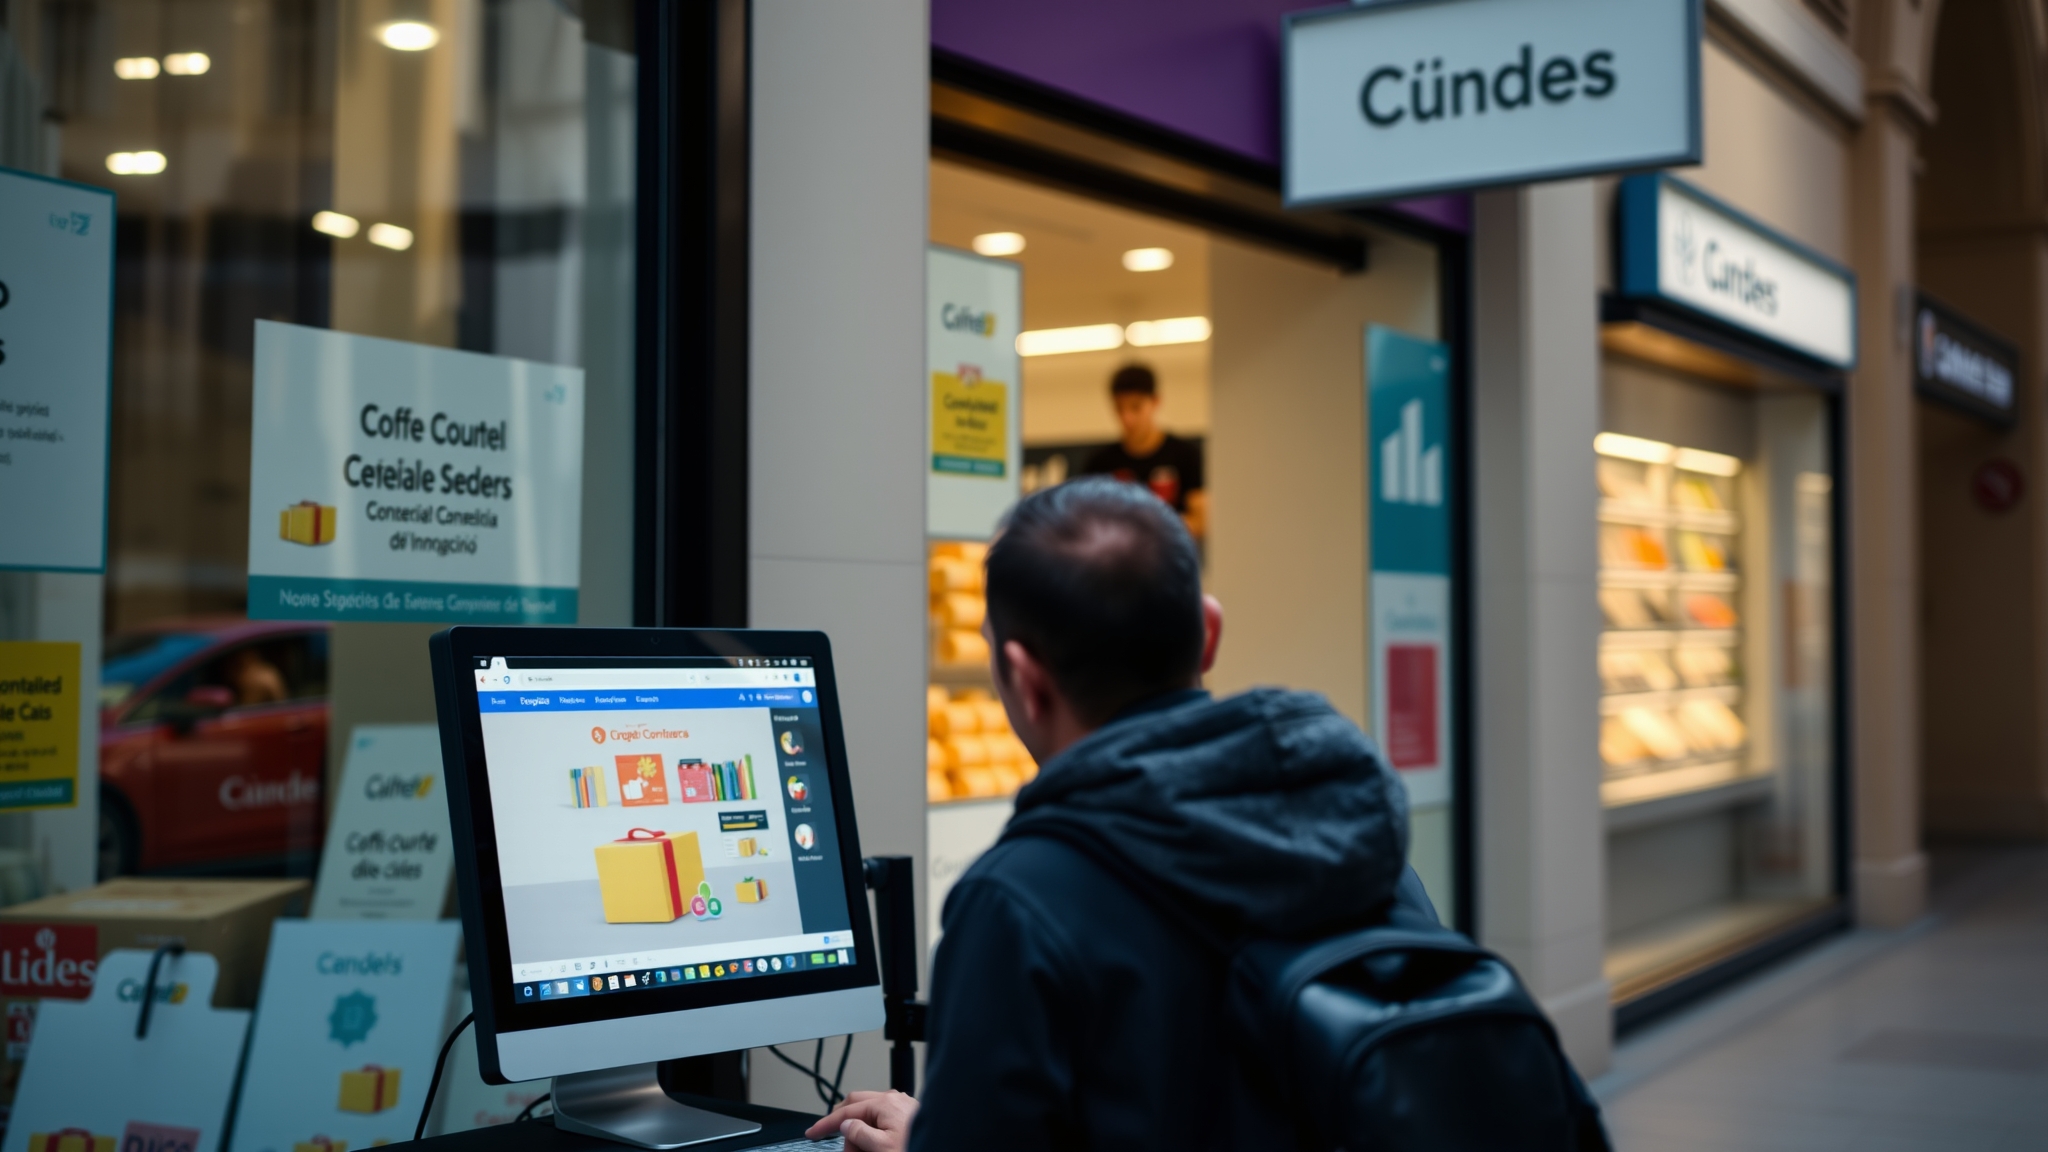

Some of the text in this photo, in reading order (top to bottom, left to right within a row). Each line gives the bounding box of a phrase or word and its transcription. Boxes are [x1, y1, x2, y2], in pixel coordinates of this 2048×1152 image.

[1360, 44, 1616, 128] Cündes
[360, 403, 506, 450] Coffe Courtel
[441, 463, 512, 500] Seders
[3, 948, 96, 987] Lides
